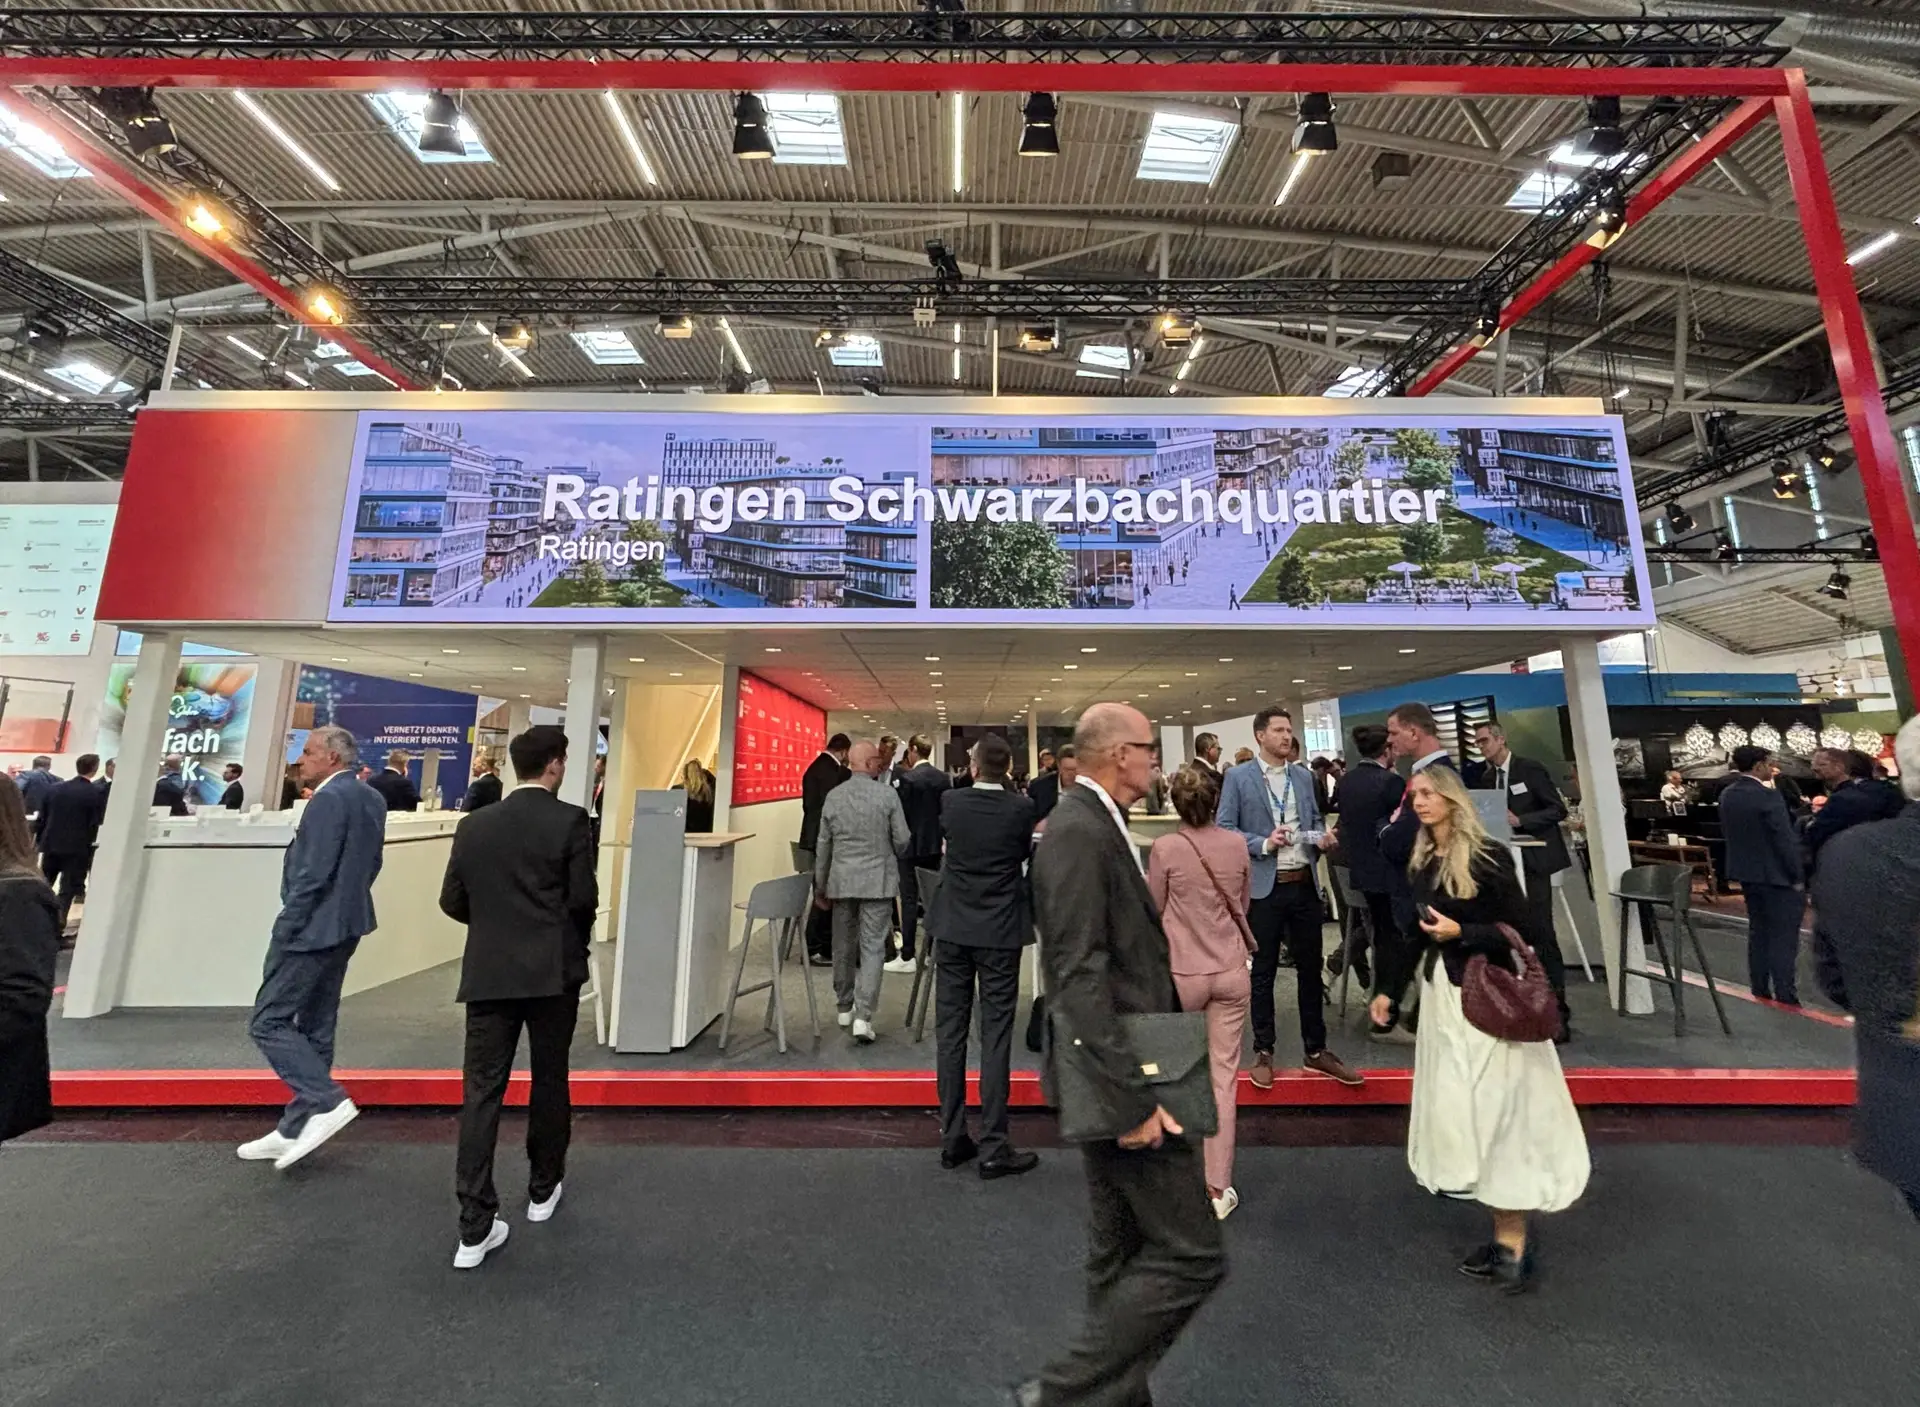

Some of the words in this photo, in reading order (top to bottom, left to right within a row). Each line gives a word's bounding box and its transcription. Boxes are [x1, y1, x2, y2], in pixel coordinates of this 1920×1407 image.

[543, 474, 806, 533] Ratingen
[826, 476, 1446, 534] Schwarzbachquartier
[539, 535, 666, 567] Ratingen
[161, 727, 221, 753] fach
[373, 735, 420, 744] INTEGRIERT
[421, 735, 460, 744] BERATEN.
[383, 725, 425, 734] VERNETZT
[426, 725, 462, 734] DENKEN.
